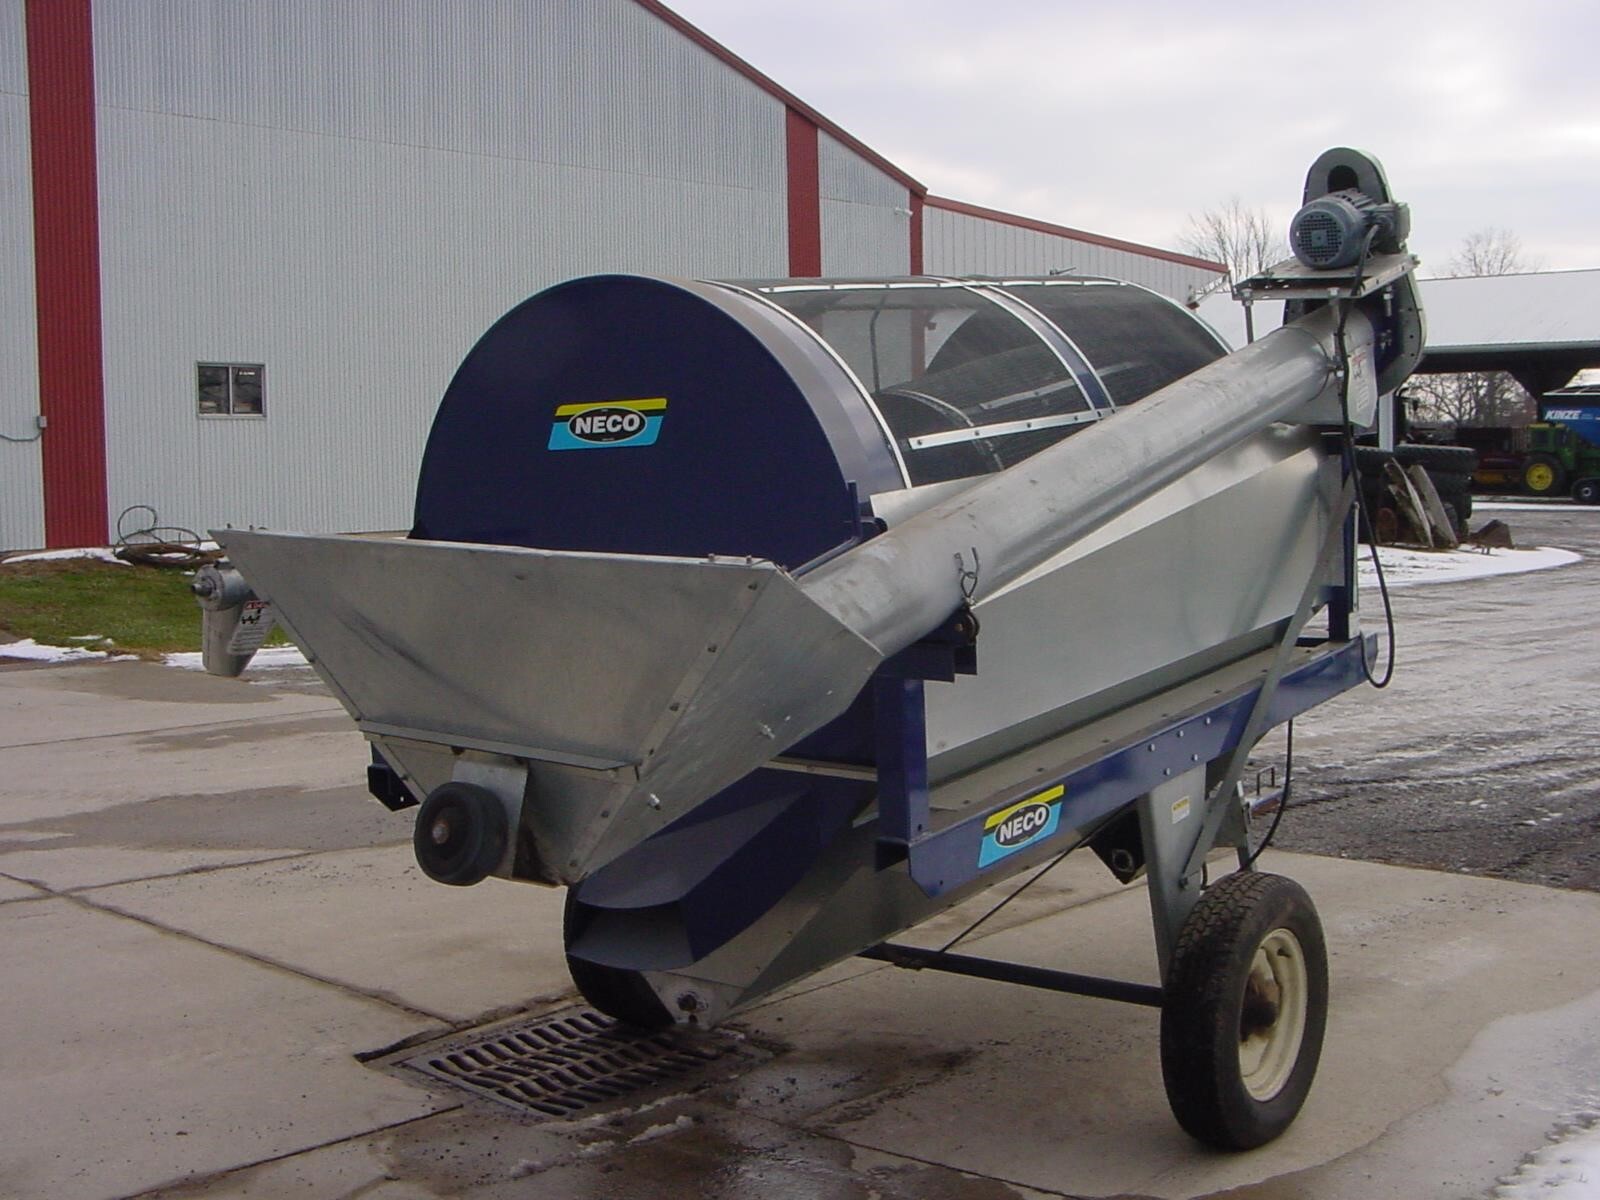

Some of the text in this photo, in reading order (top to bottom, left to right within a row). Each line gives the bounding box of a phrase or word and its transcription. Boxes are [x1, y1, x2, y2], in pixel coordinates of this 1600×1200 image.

[575, 413, 641, 435] NECO
[1544, 409, 1582, 420] KINZE
[999, 806, 1047, 843] NECO
